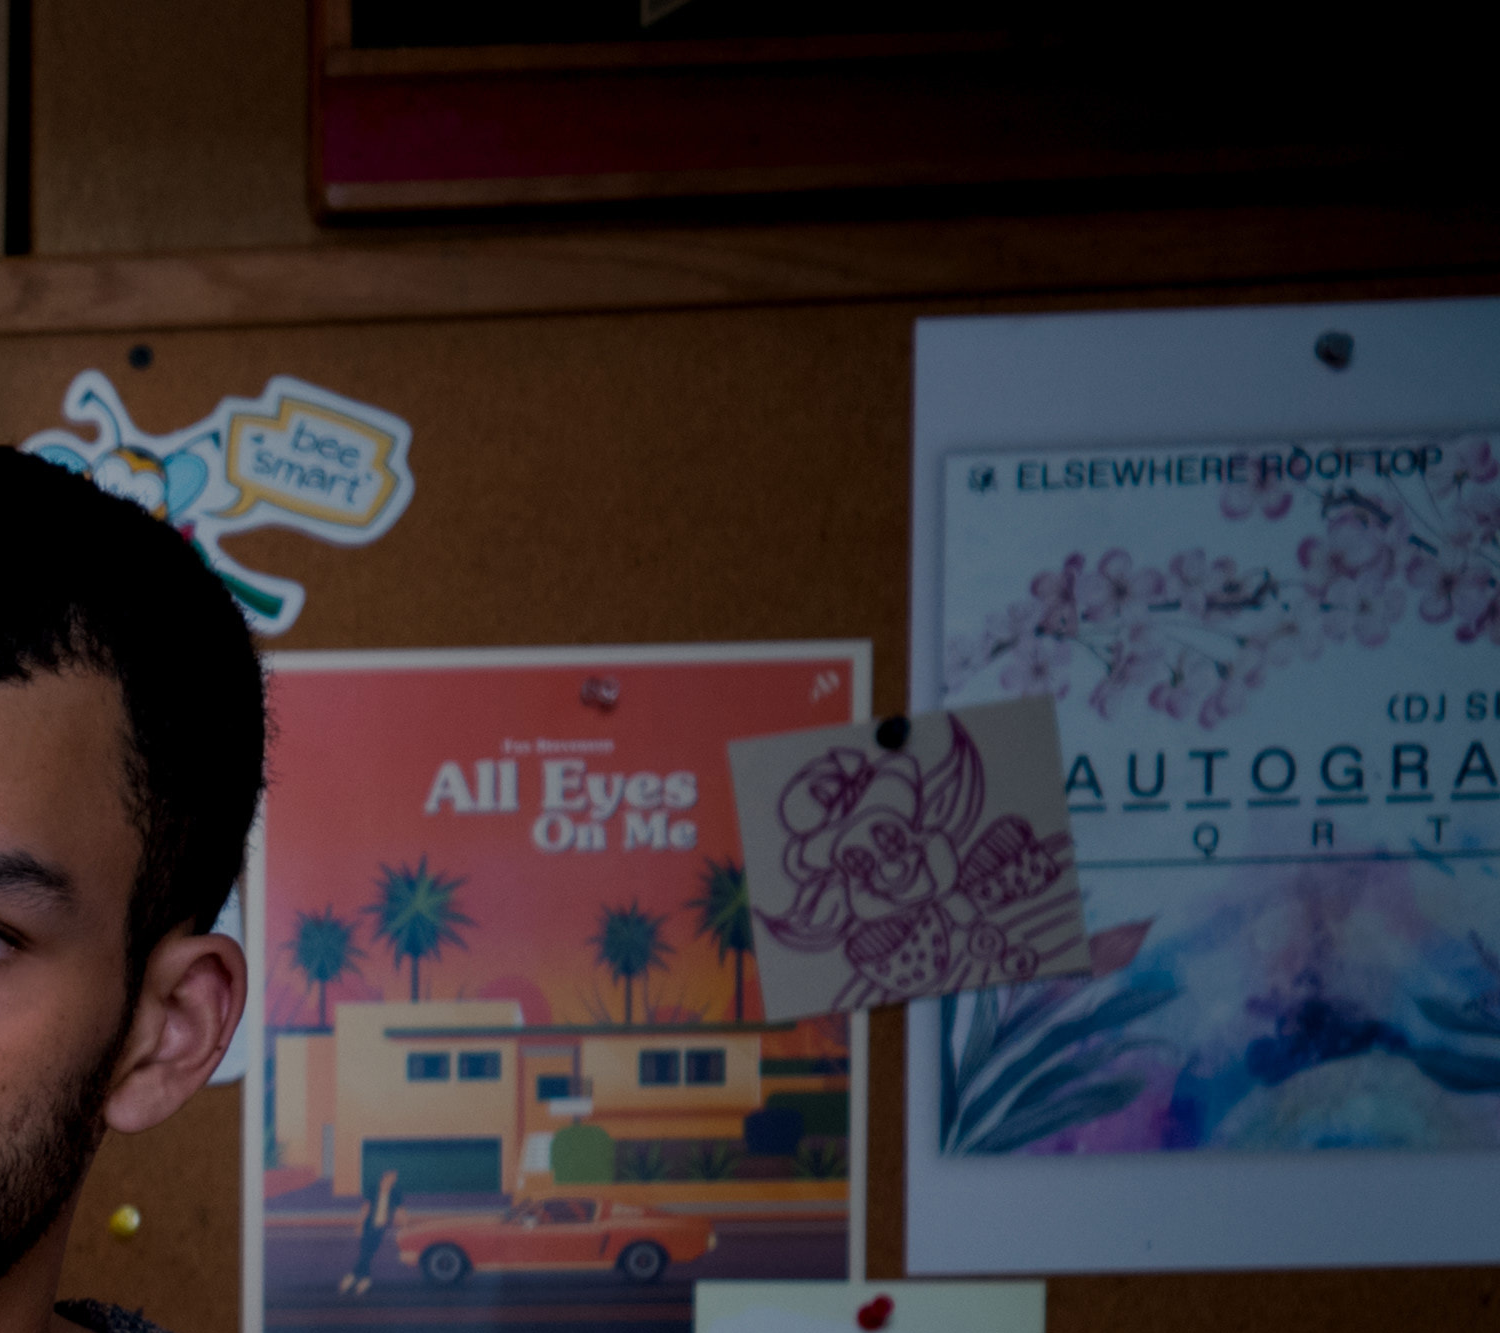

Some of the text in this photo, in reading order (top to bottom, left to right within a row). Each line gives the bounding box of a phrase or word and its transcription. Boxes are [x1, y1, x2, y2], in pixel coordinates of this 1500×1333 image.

[291, 420, 360, 468] bee
[1016, 446, 1443, 492] ELSEWHERE ROOFTOP
[1387, 691, 1446, 722] (DJ
[424, 759, 698, 821] All Eyes
[1065, 741, 1498, 800] AUTOGRA
[532, 811, 698, 853] On Me
